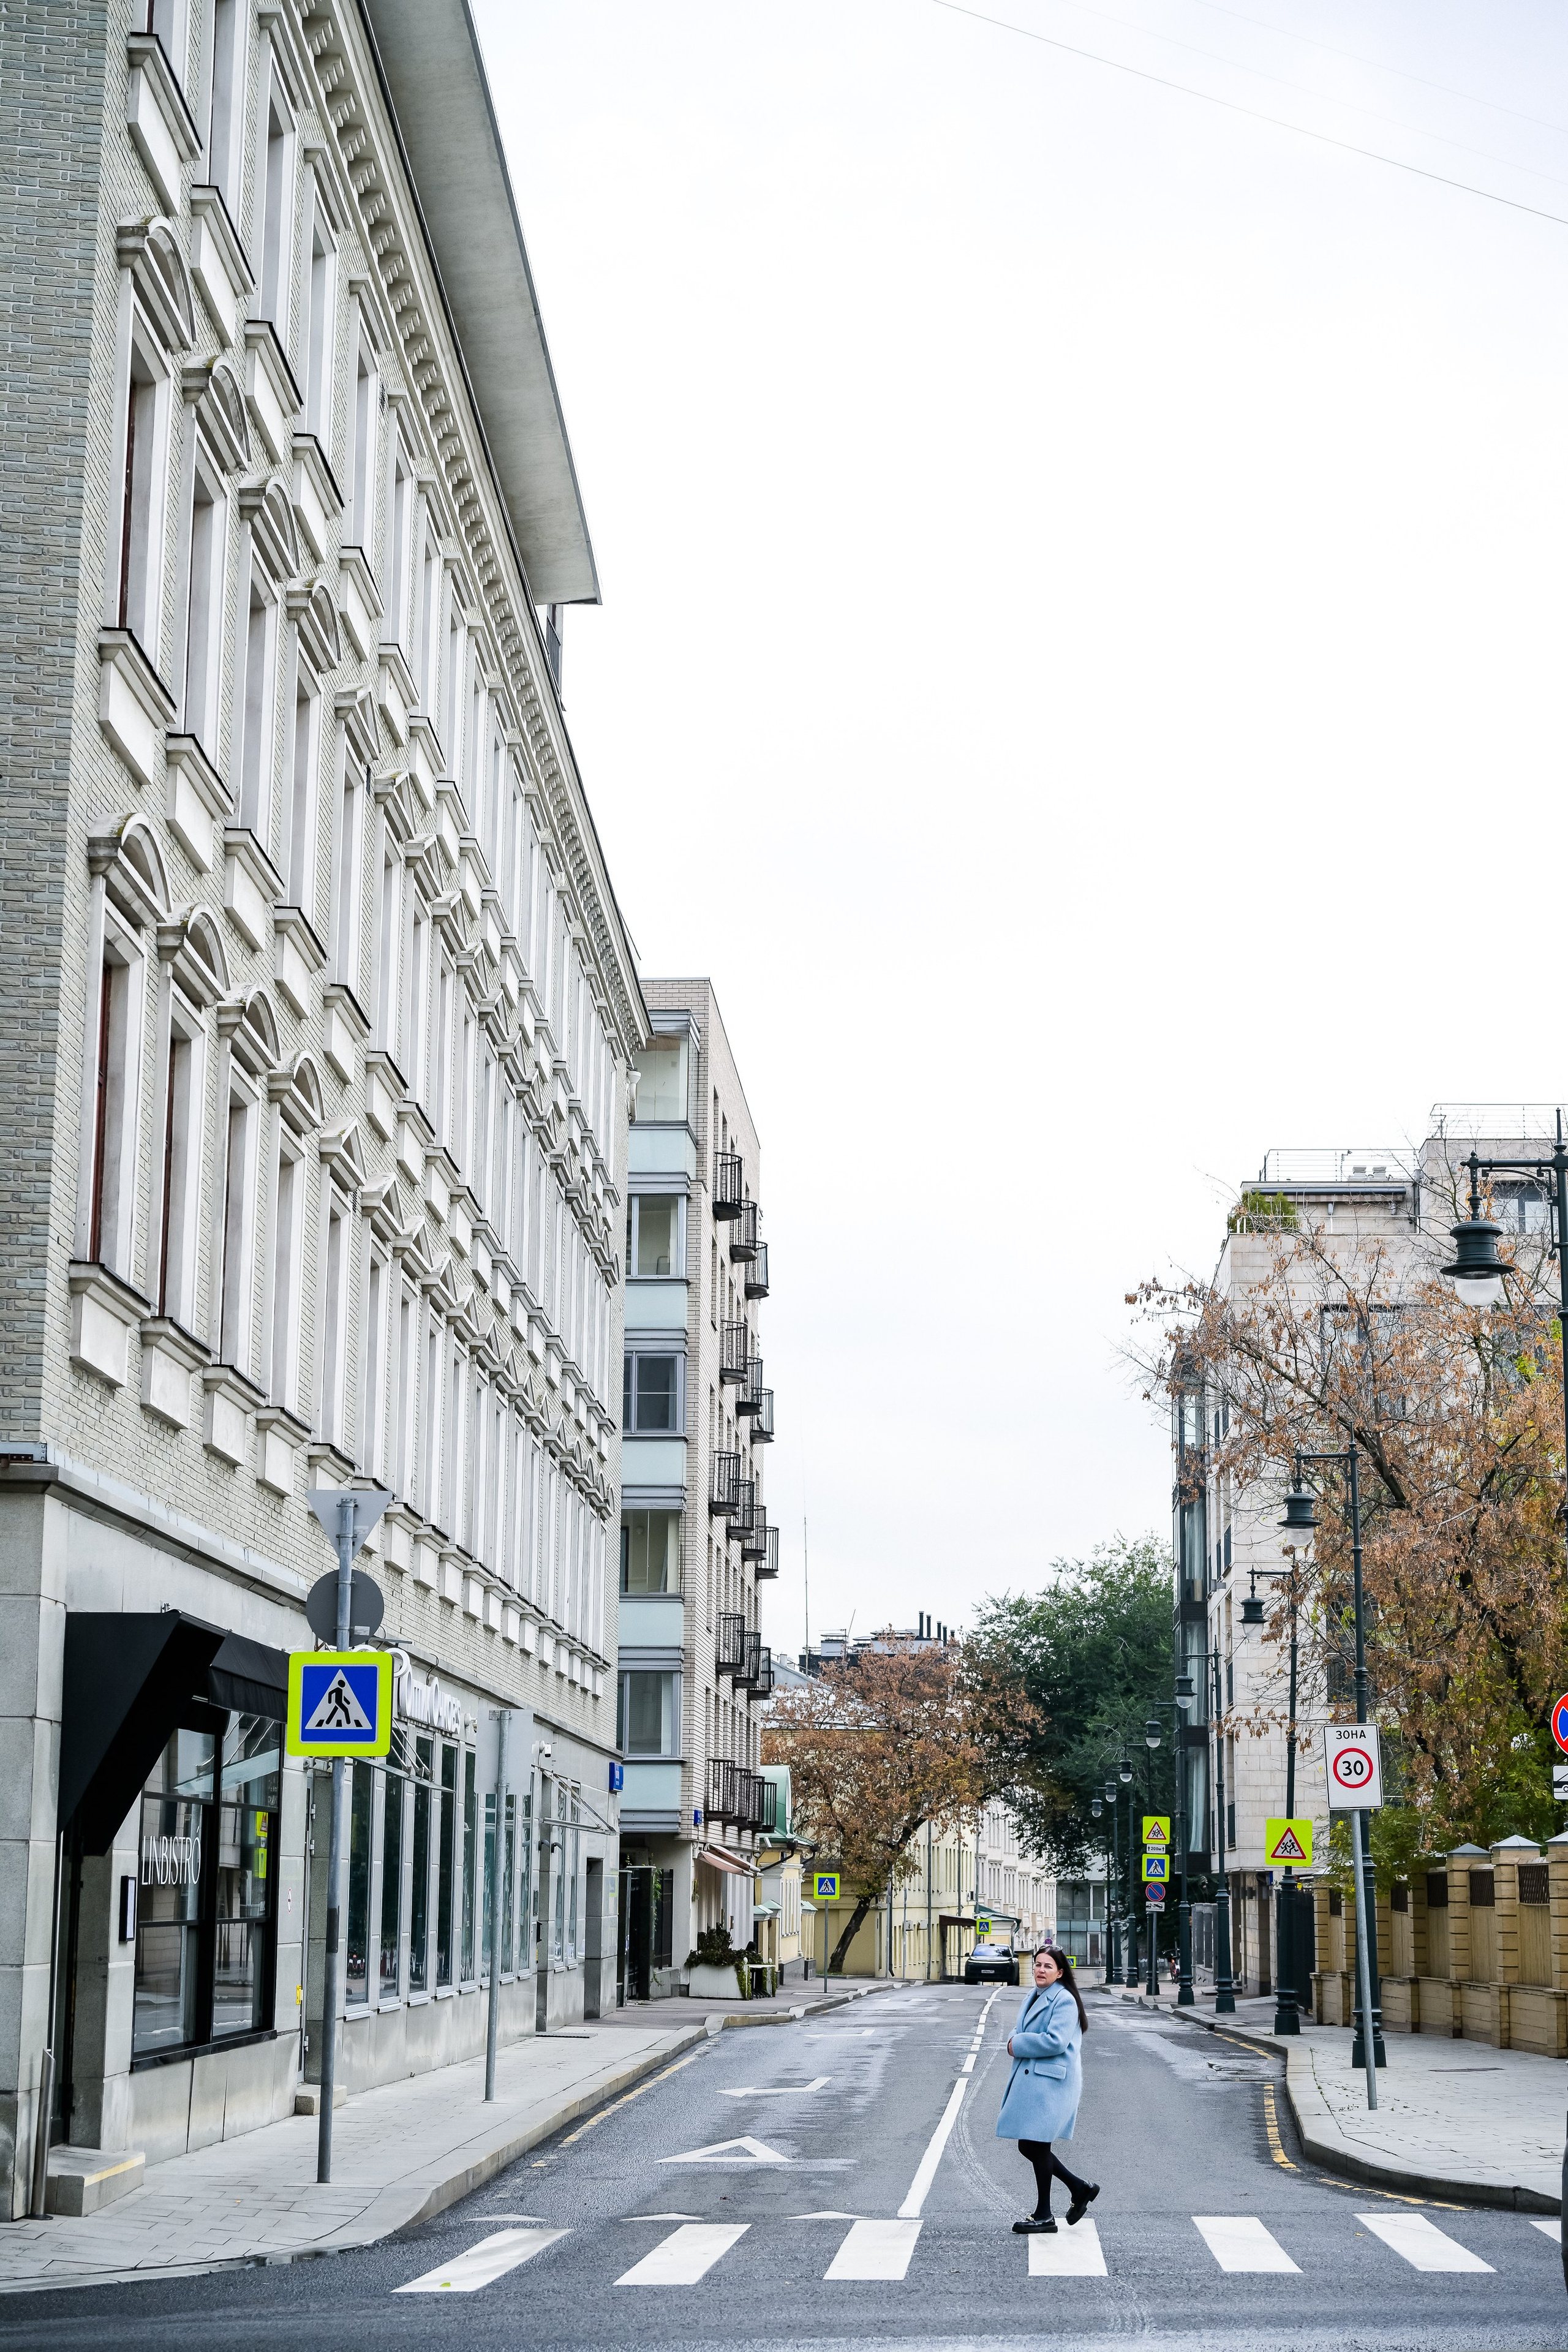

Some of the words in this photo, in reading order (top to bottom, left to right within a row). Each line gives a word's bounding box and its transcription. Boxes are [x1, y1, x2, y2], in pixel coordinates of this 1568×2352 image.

[1336, 1730, 1366, 1740] ЗОНА
[1342, 1760, 1364, 1776] 30
[141, 1825, 202, 1885] LINBISTRÓ
